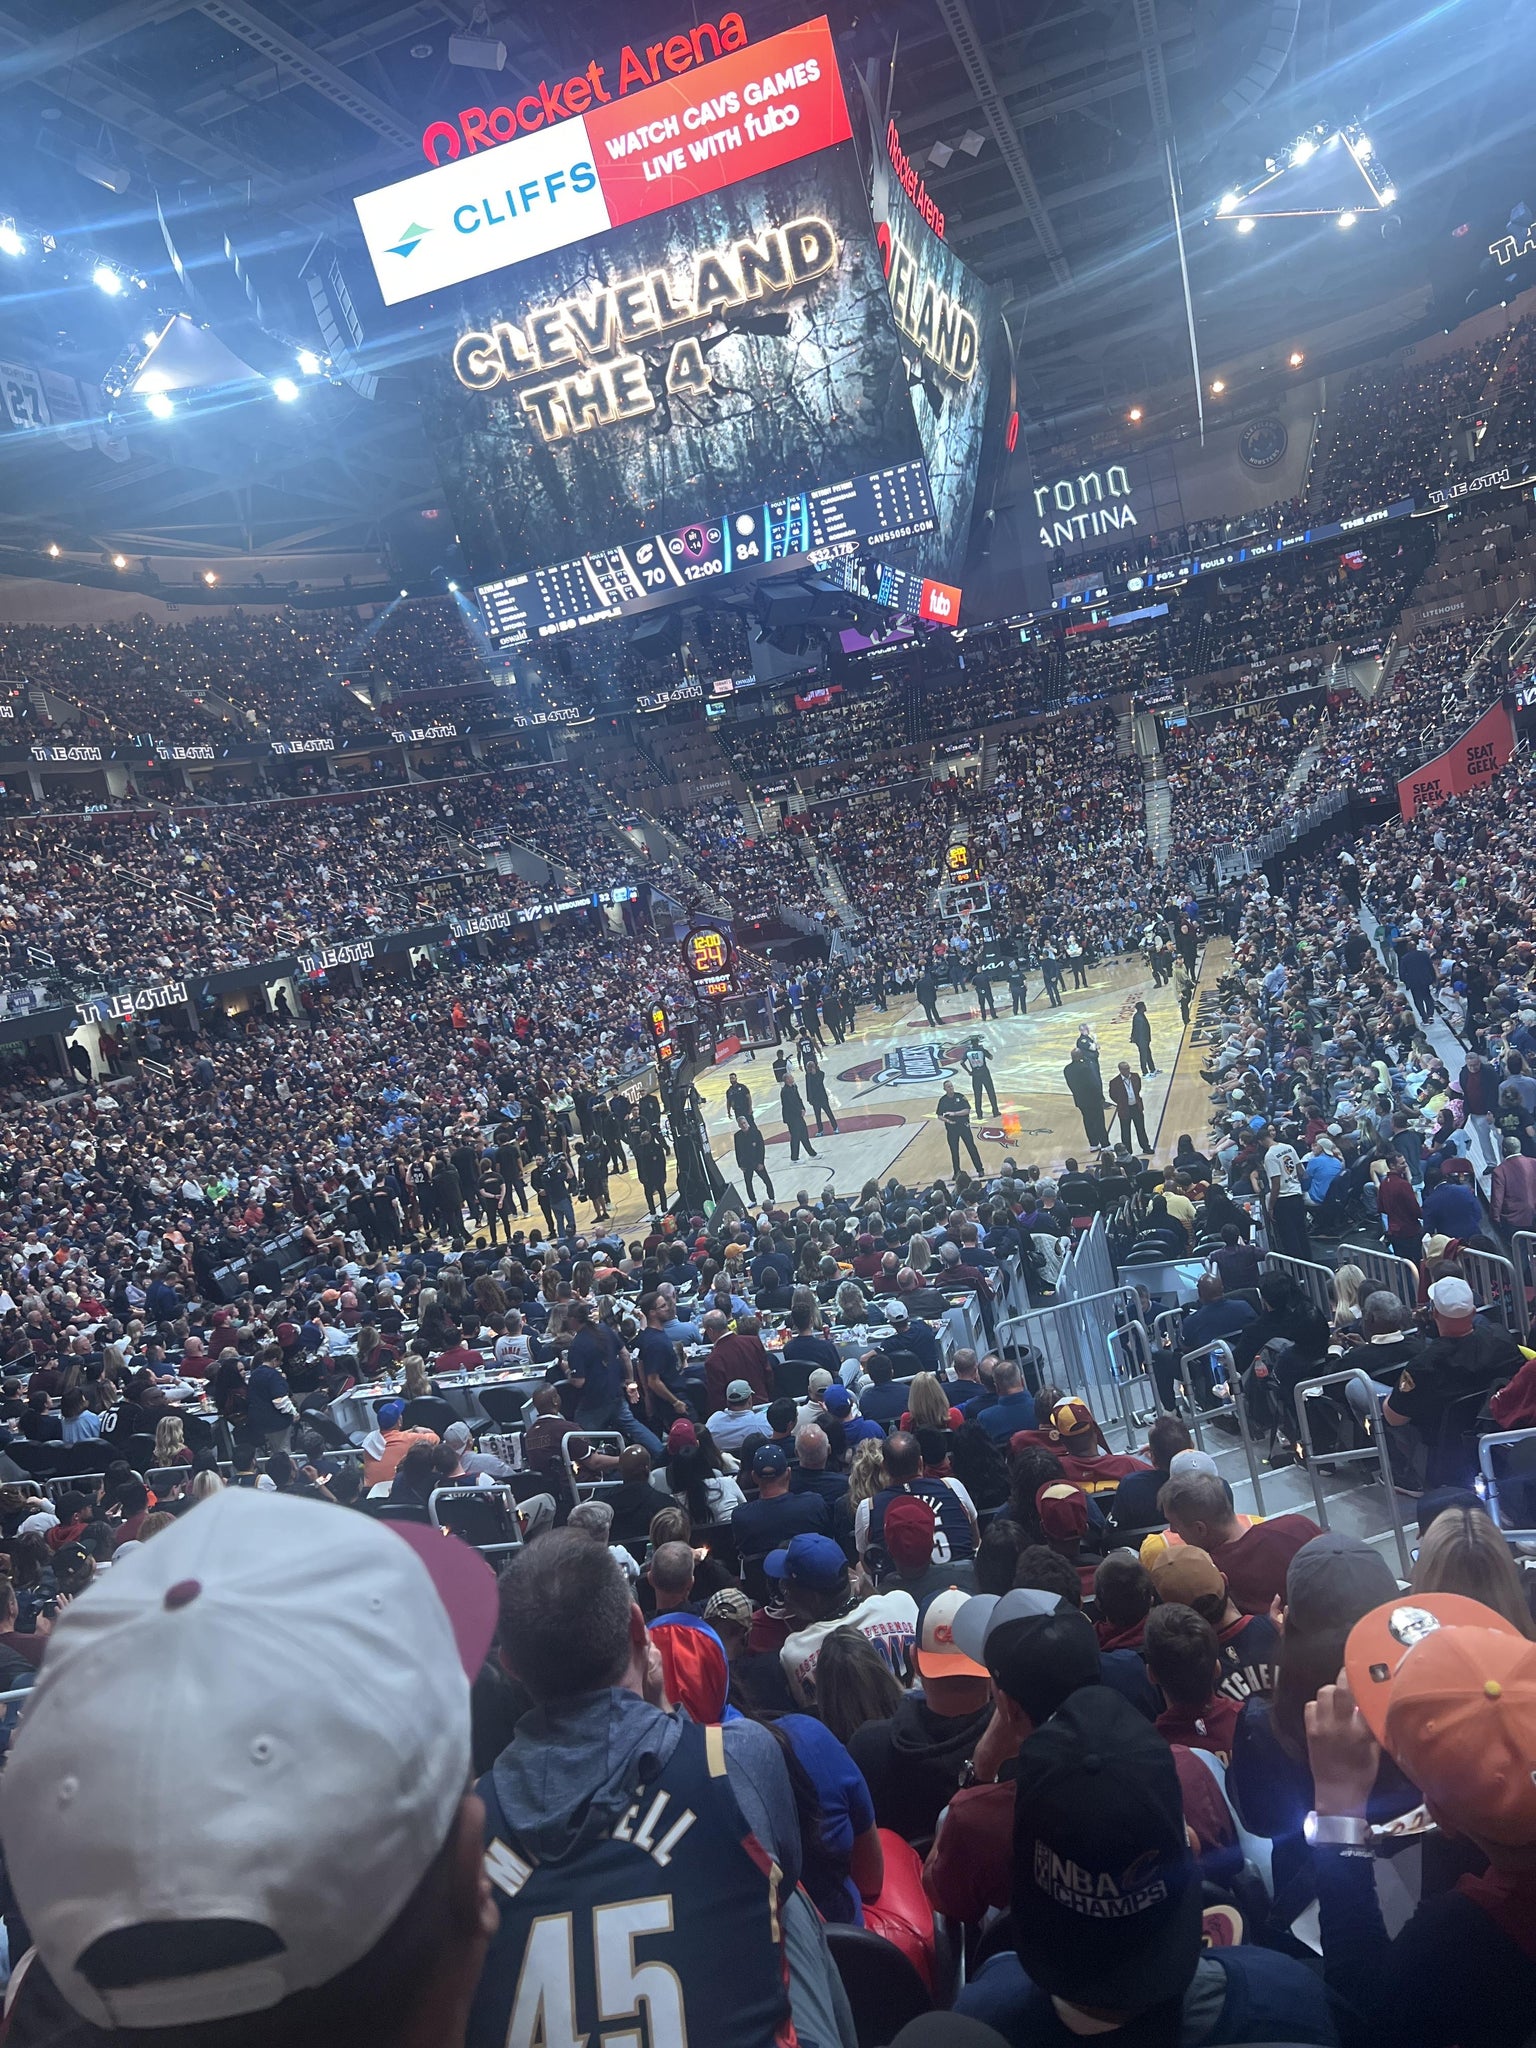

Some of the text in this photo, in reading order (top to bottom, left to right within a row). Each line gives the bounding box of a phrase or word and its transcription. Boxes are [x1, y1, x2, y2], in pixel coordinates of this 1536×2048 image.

[458, 12, 748, 153] Rocket Arena
[605, 58, 821, 160] WATCH CAVS GAMES
[642, 104, 800, 182] LIVE WITH fubo
[890, 128, 946, 240] Rocket Arena
[453, 161, 597, 234] CLIFFS
[453, 216, 838, 390] CLEVELAND
[520, 337, 712, 442] THE 4
[1468, 468, 1510, 492] 4TH
[1340, 509, 1388, 530] THE 4TH
[867, 519, 934, 546] CAVS5050.COM
[736, 541, 759, 560] 84
[1251, 546, 1266, 556] TOL
[684, 559, 723, 580] 12:00
[1201, 558, 1225, 570] FOULS
[642, 567, 666, 587] 70
[929, 589, 951, 616] fubo
[1422, 602, 1465, 619] LITEHOUSE
[500, 629, 528, 645] oswald
[735, 675, 756, 686] oswald
[670, 686, 702, 701] 4TH
[547, 708, 579, 722] 4TH
[425, 725, 457, 739] 4TH
[67, 747, 102, 761] 4TH
[185, 747, 214, 759] 4TH
[303, 738, 334, 752] 4TH
[1467, 742, 1494, 761] SEAT
[1467, 756, 1499, 776] GEEK
[1413, 779, 1440, 794] SEAT
[949, 854, 967, 868] 24
[480, 912, 511, 933] 4TH
[694, 934, 721, 949] 12:00
[338, 941, 375, 963] 4TH
[695, 948, 723, 971] 24
[704, 974, 731, 984] TISSOT
[135, 981, 188, 1010] 4TH
[802, 1044, 811, 1054] 45
[413, 1173, 425, 1184] 32
[1052, 1852, 1120, 1897] NBA
[1054, 1879, 1168, 1918] CHAMPS
[505, 1893, 689, 2048] 45
